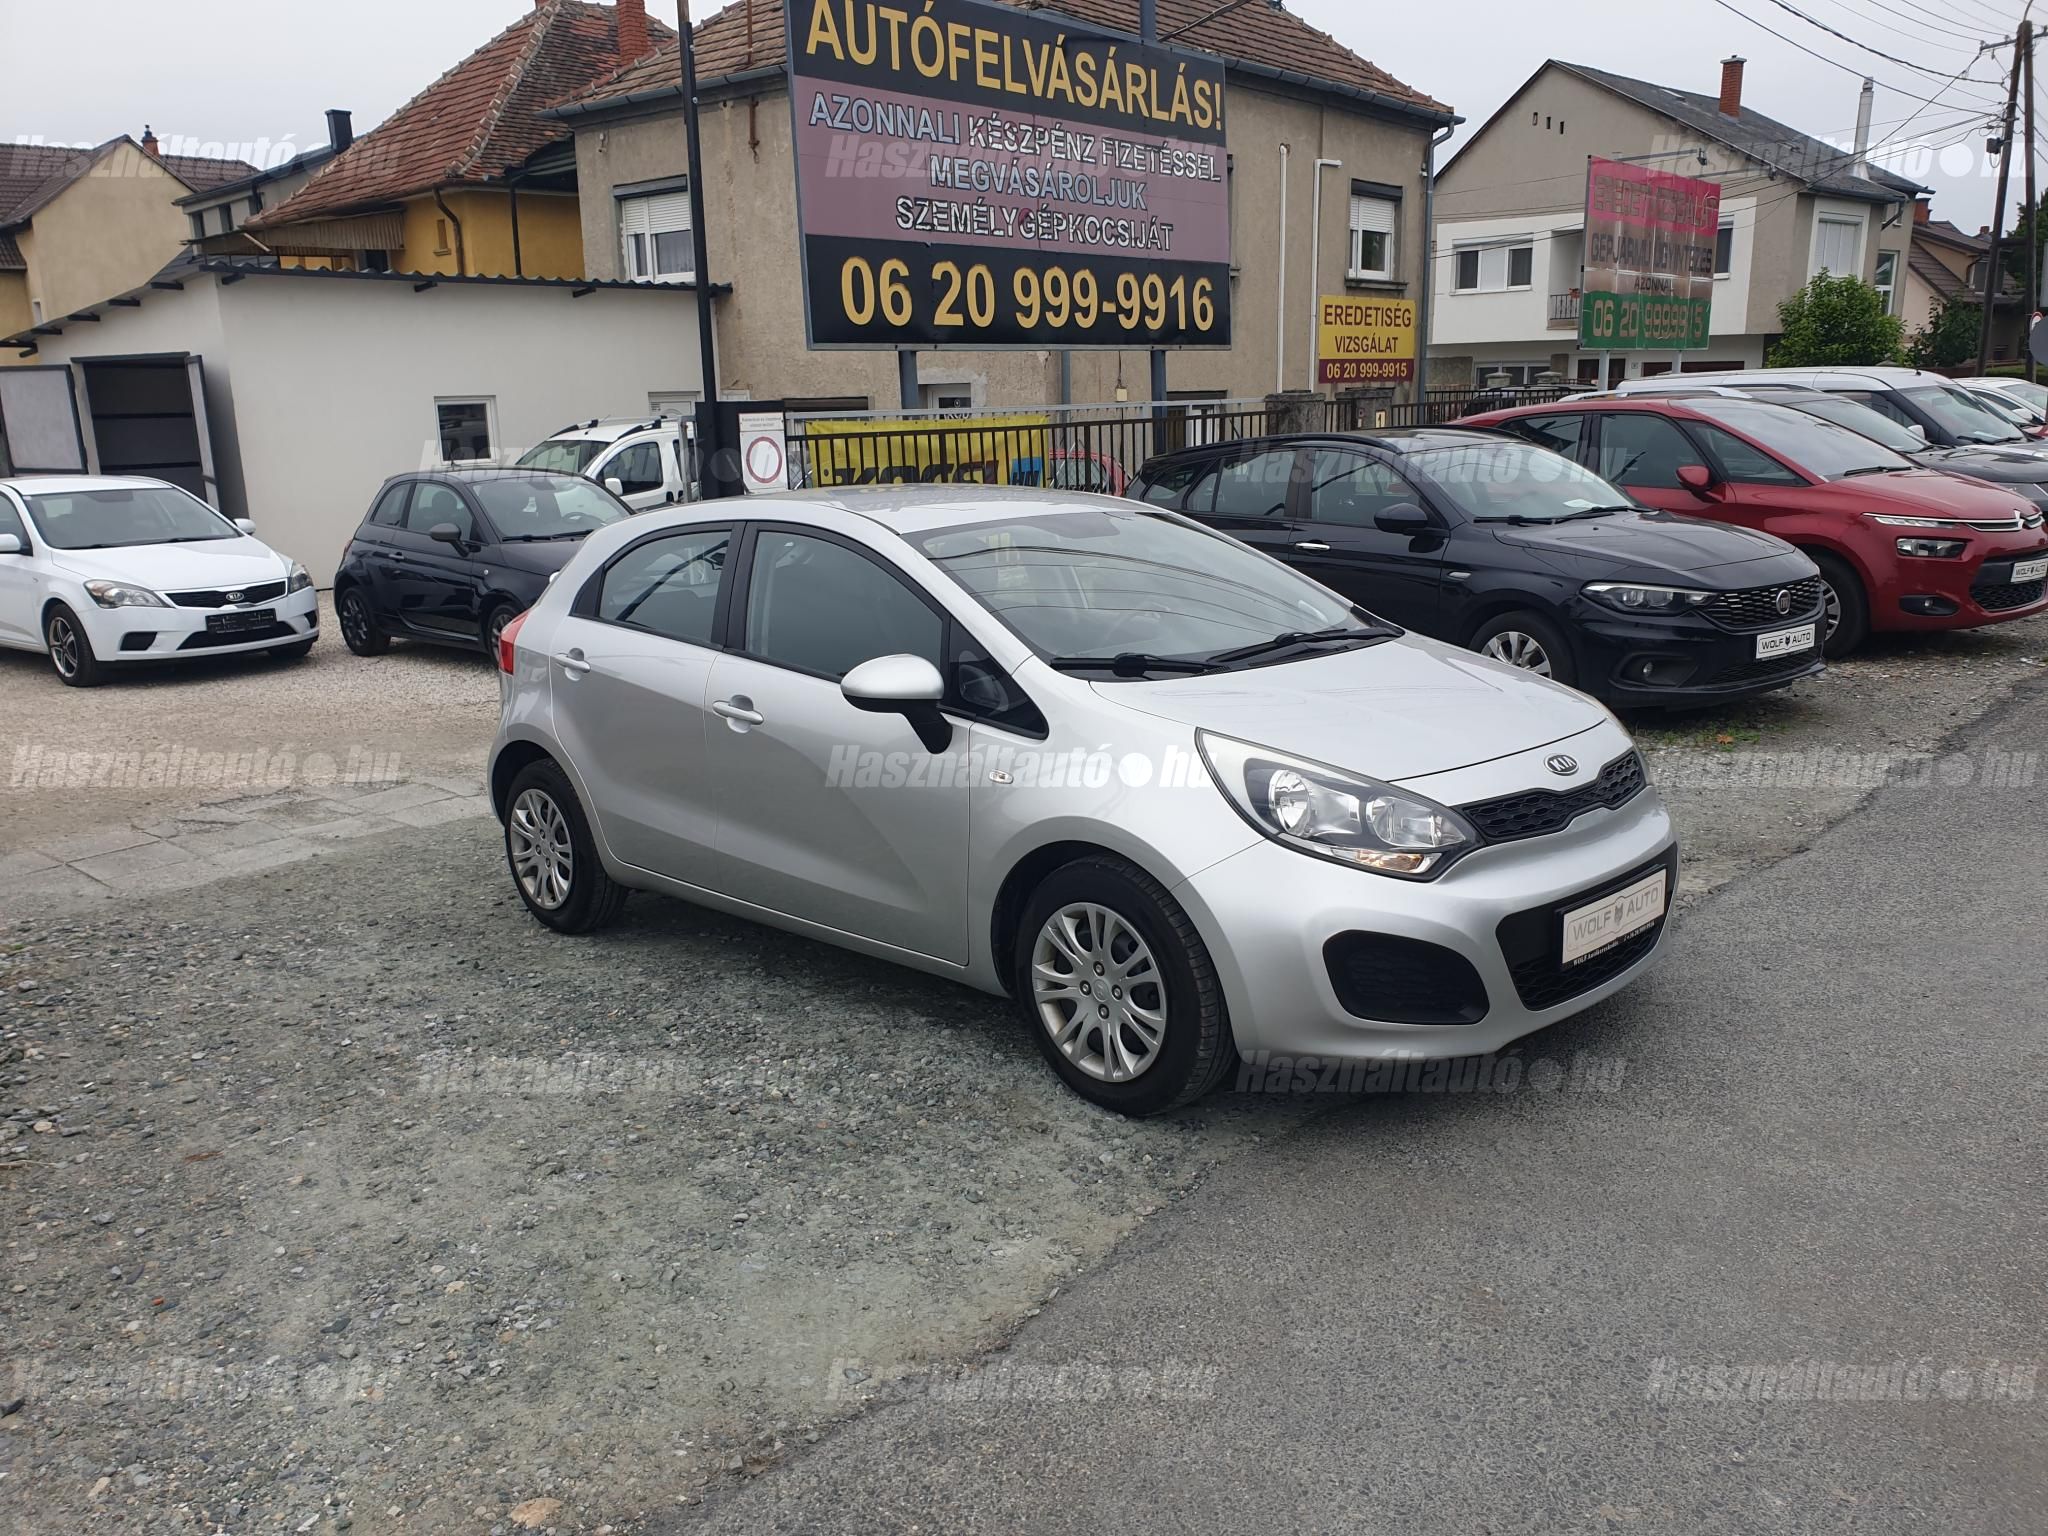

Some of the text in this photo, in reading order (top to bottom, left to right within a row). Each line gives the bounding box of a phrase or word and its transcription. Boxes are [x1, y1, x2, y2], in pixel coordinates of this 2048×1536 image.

[806, 0, 1223, 130] AUTÓFELVÁSÁRLÁS!
[809, 92, 1222, 183] AZONNALI KÉSZPÉNZ FIZETÉSSEL
[930, 153, 1148, 211] MEGVÁSÁROLJUK
[895, 195, 1174, 252] SZEMÉLYGÉPKOCSIJÁT
[841, 256, 1214, 332] 06 20 999-9916
[1324, 302, 1412, 328] EREDETISÉG
[1593, 299, 1614, 338] 06
[1619, 301, 1639, 337] 20
[1334, 332, 1398, 353] VIZSGÁLAT
[1327, 362, 1407, 379] 06 20 999-9915
[1762, 632, 1811, 650] WOLF AUTO
[1548, 755, 1578, 773] KIA
[1573, 911, 1612, 941] WOLF
[1627, 887, 1658, 918] AUTO
